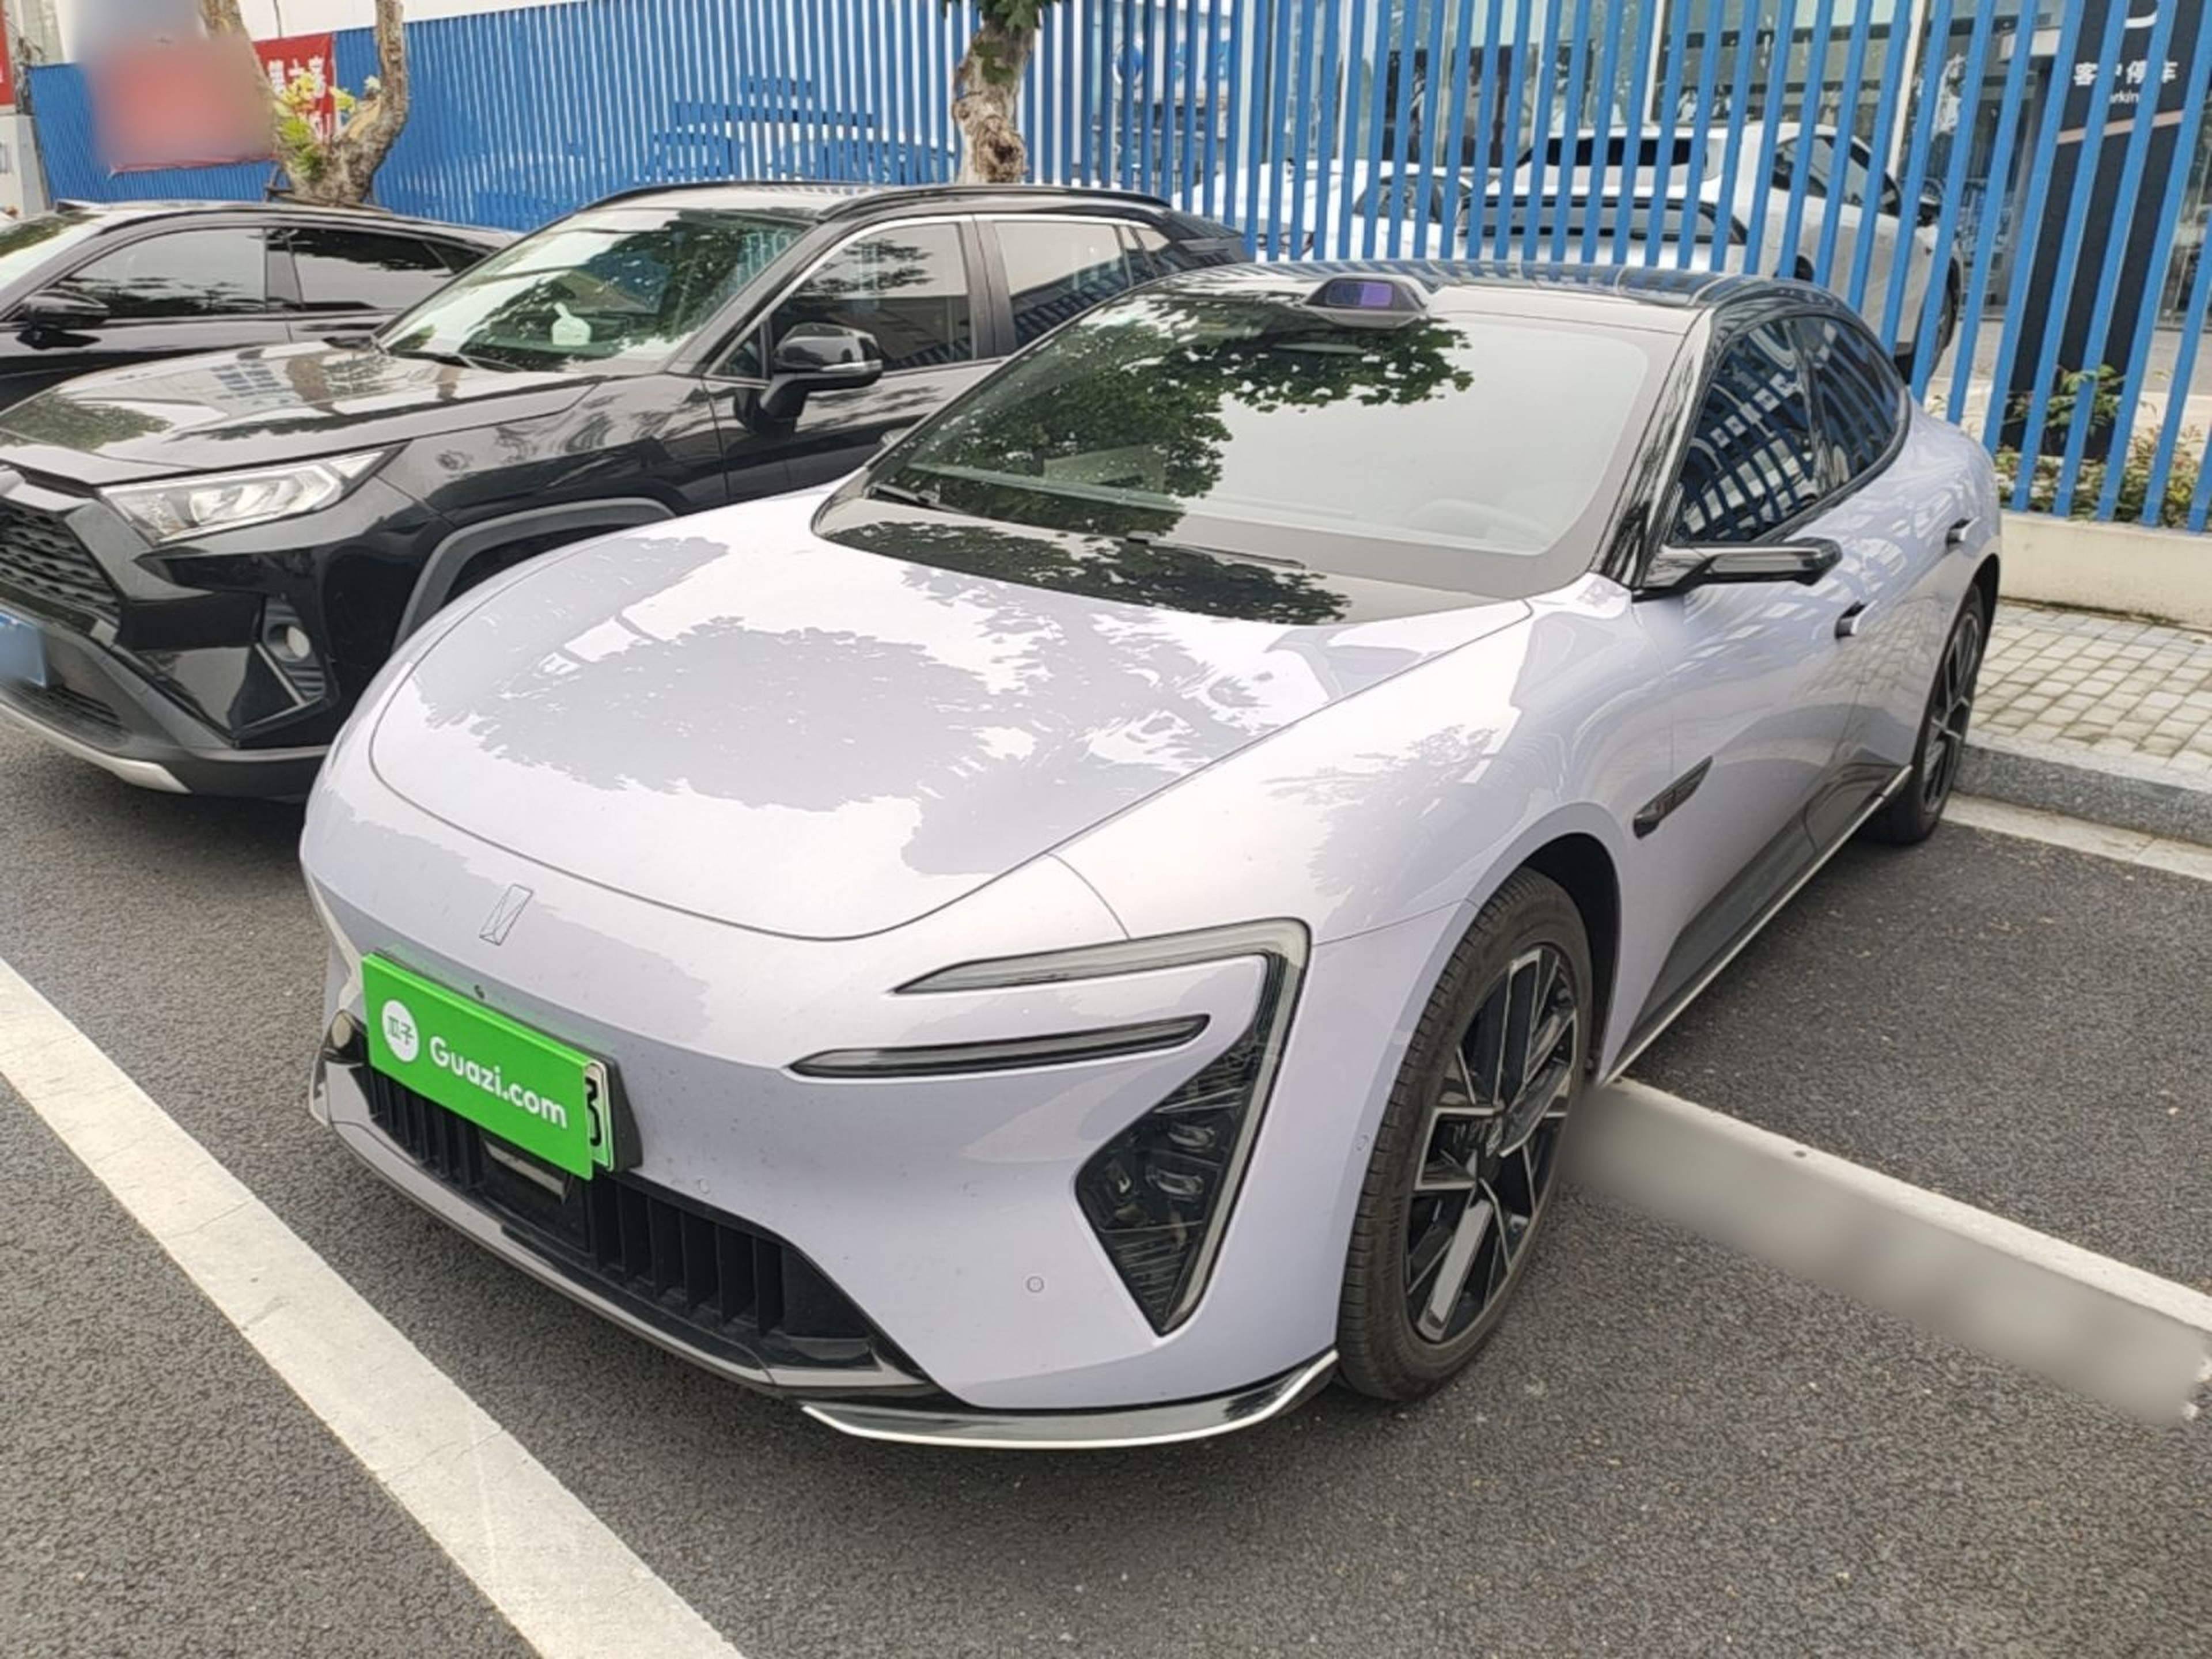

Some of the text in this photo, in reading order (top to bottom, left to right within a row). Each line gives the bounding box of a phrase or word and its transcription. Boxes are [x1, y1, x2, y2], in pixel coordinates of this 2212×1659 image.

[2074, 60, 2179, 86] 客停车
[387, 1015, 415, 1046] 瓜子
[429, 1036, 567, 1130] Guazi.com
